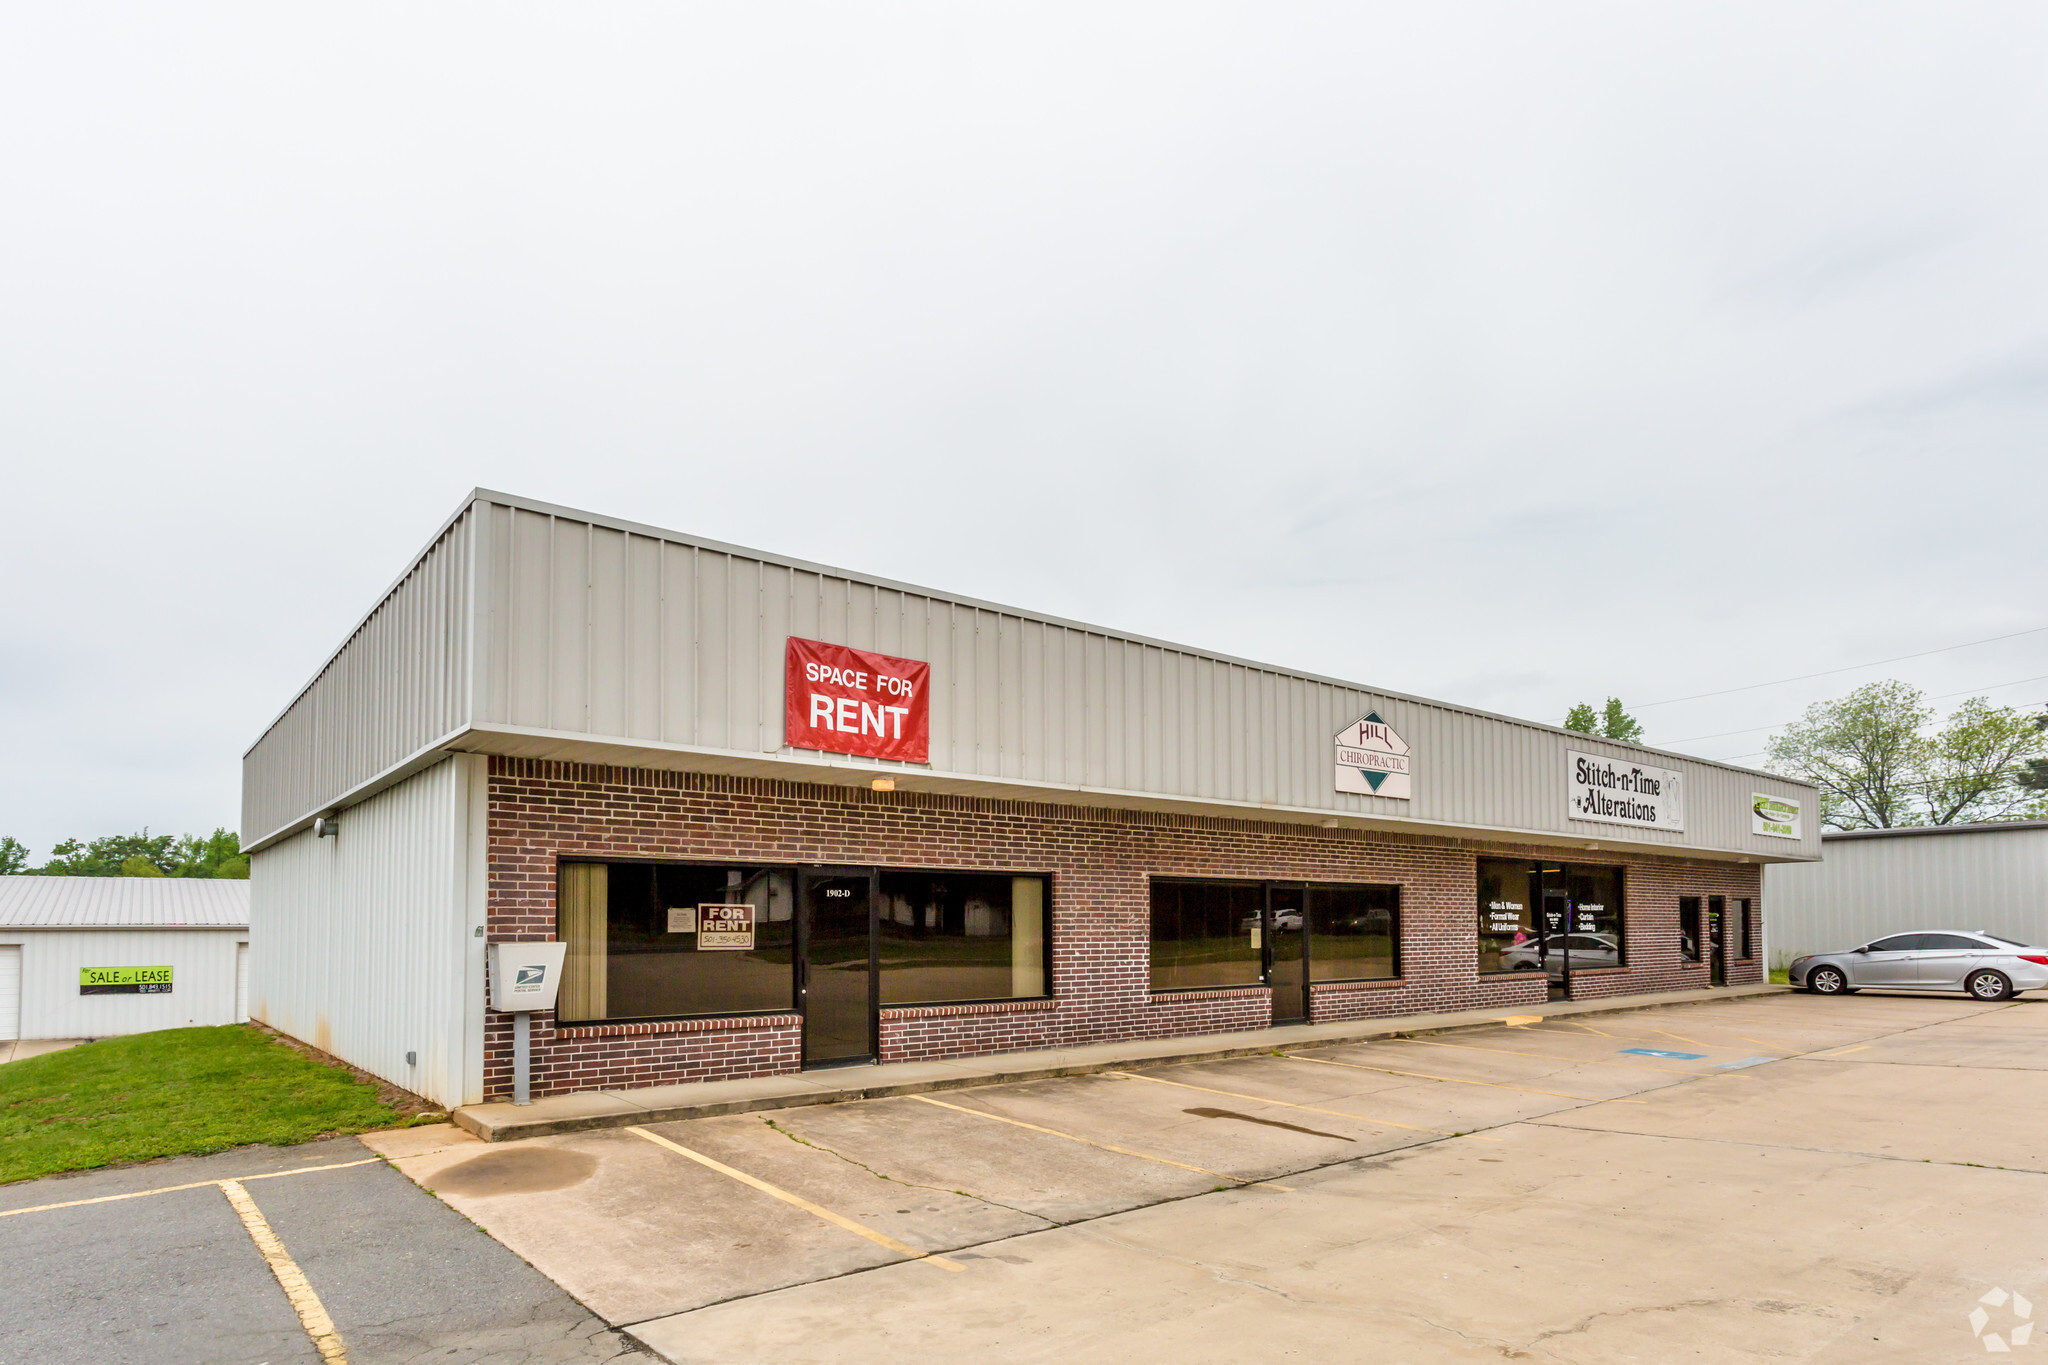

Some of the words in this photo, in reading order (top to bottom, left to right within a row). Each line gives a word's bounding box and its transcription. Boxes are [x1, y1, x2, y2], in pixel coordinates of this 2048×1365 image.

[806, 662, 868, 690] SPACE
[876, 674, 912, 697] FOR
[809, 693, 909, 740] RENT
[1359, 722, 1393, 750] HILL
[1340, 750, 1405, 771] CHIROPRACTIC
[1576, 757, 1660, 796] Stitch-n-Time
[1583, 788, 1656, 822] Alterations
[826, 889, 850, 898] 1902-D
[709, 907, 744, 920] FOR
[1491, 911, 1507, 921] Formal
[1507, 912, 1519, 921] Wear
[703, 920, 750, 931] RENT
[90, 971, 120, 983] SALE
[135, 970, 169, 982] LEASE
